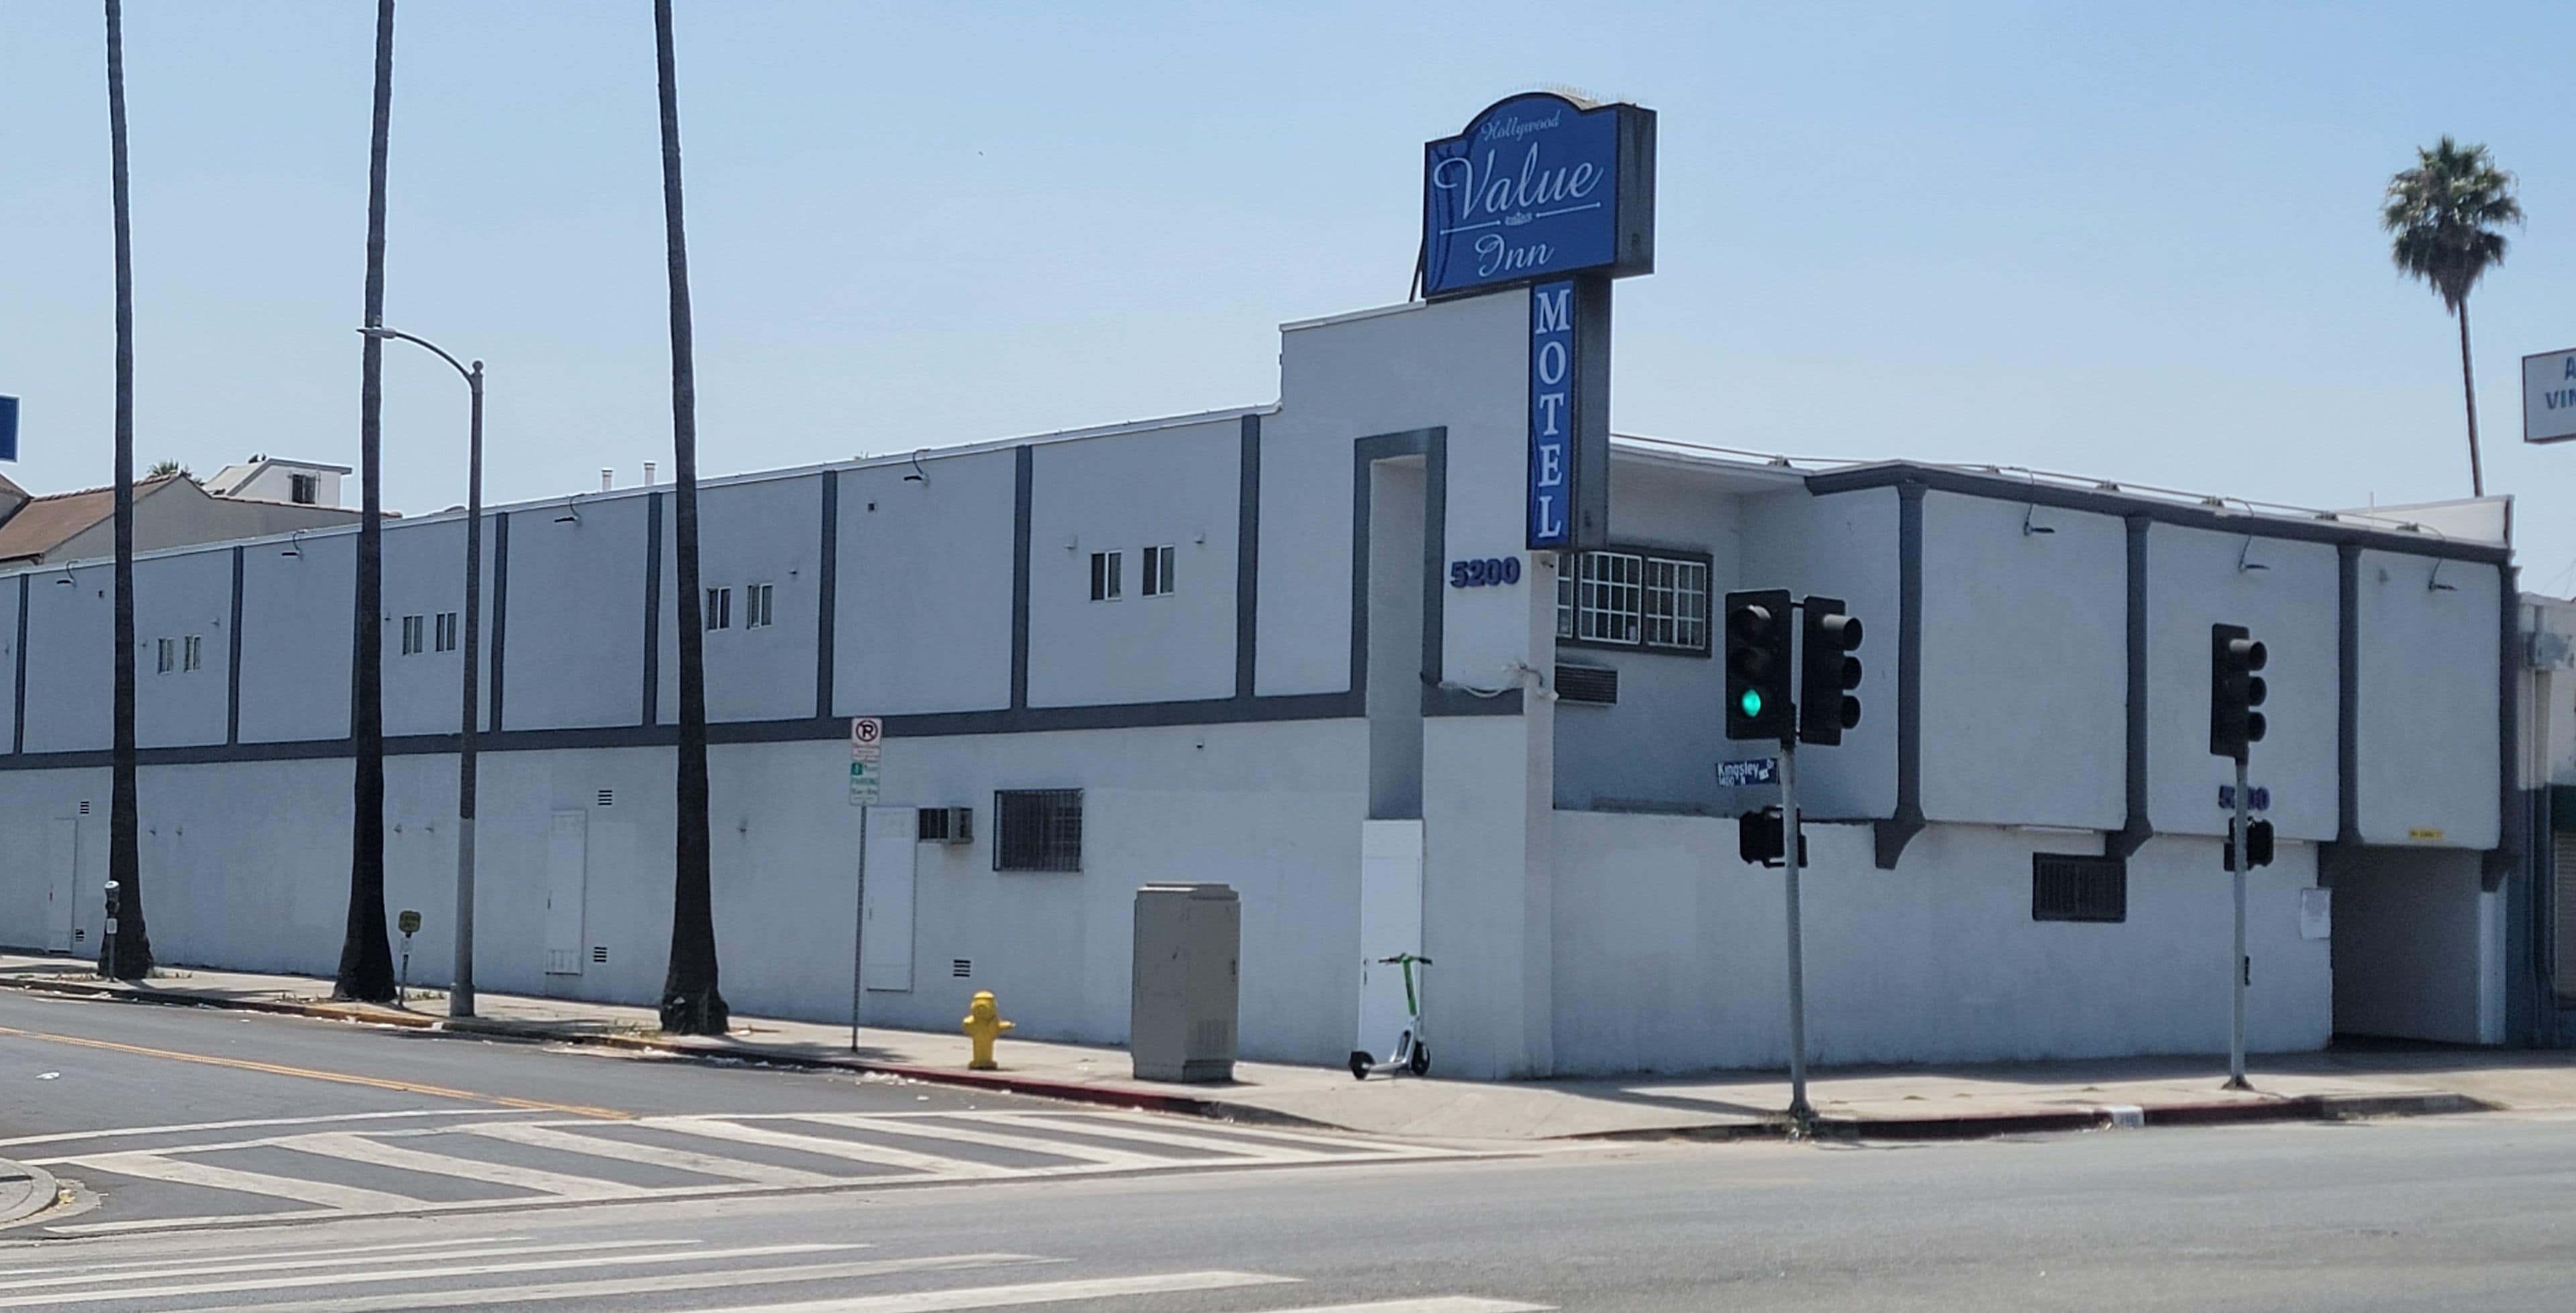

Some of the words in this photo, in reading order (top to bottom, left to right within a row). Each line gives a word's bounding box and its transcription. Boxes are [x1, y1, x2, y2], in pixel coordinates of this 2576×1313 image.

[1481, 109, 1561, 141] Hollywood
[1434, 141, 1604, 219] Value
[1476, 233, 1554, 277] Inn
[1535, 288, 1571, 538] MOTEL
[1450, 557, 1521, 588] 5200
[1718, 762, 1759, 780] Kingsley
